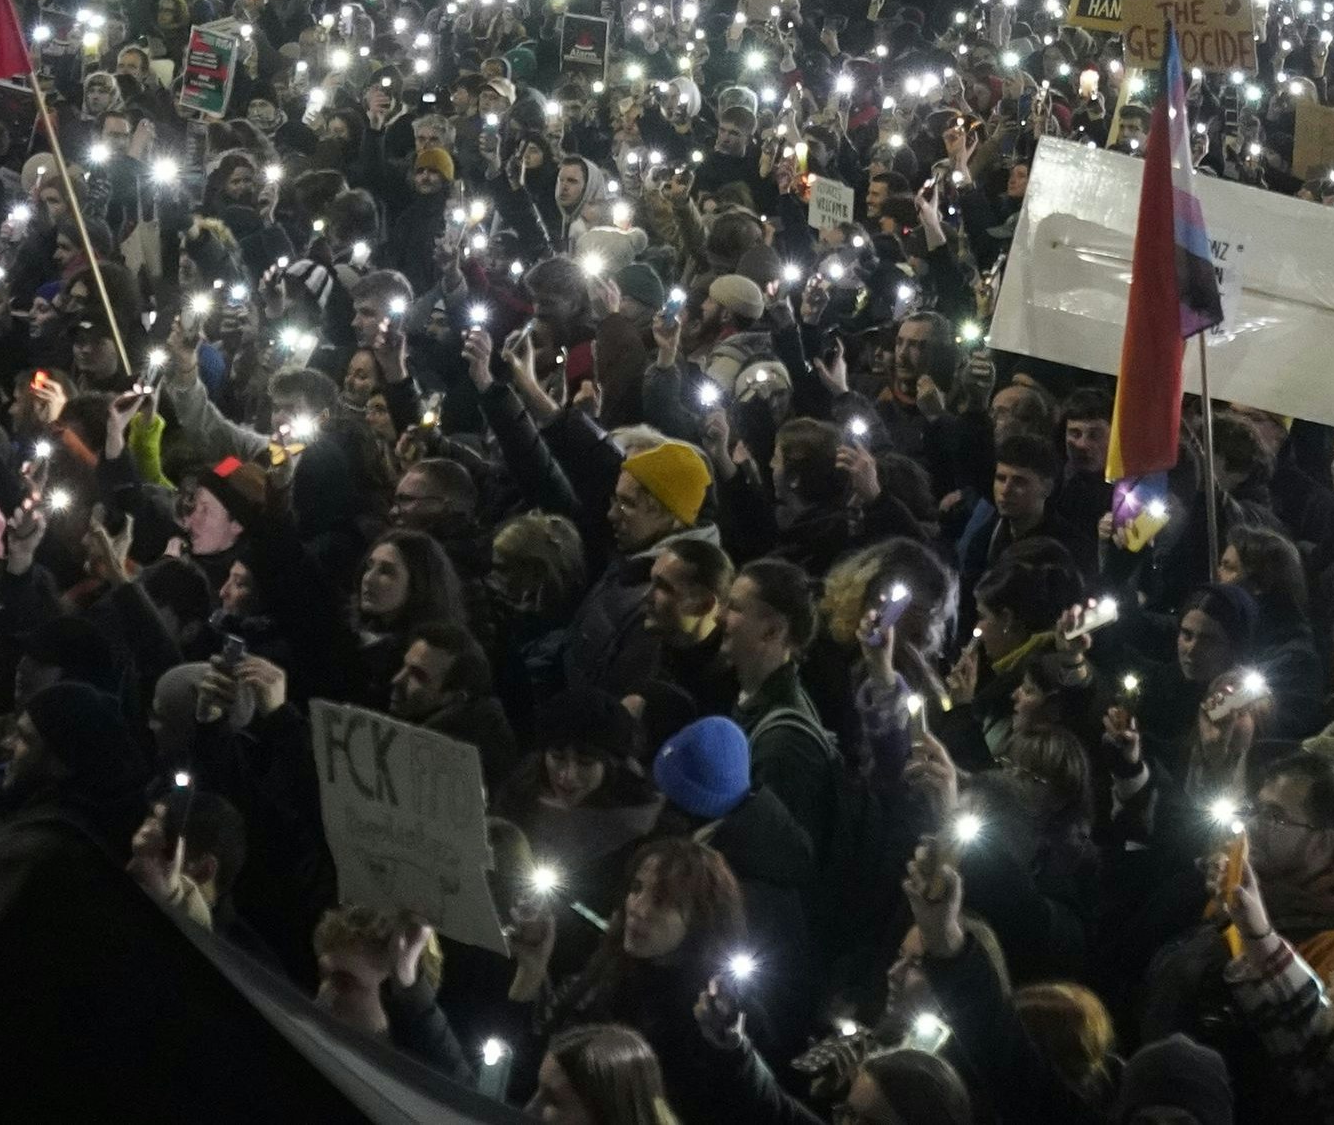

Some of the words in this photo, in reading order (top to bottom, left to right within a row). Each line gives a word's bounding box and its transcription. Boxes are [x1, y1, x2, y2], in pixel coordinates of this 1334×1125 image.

[1155, 0, 1207, 26] THE
[1126, 24, 1253, 69] GEOCIDE
[321, 707, 400, 807] FCK
